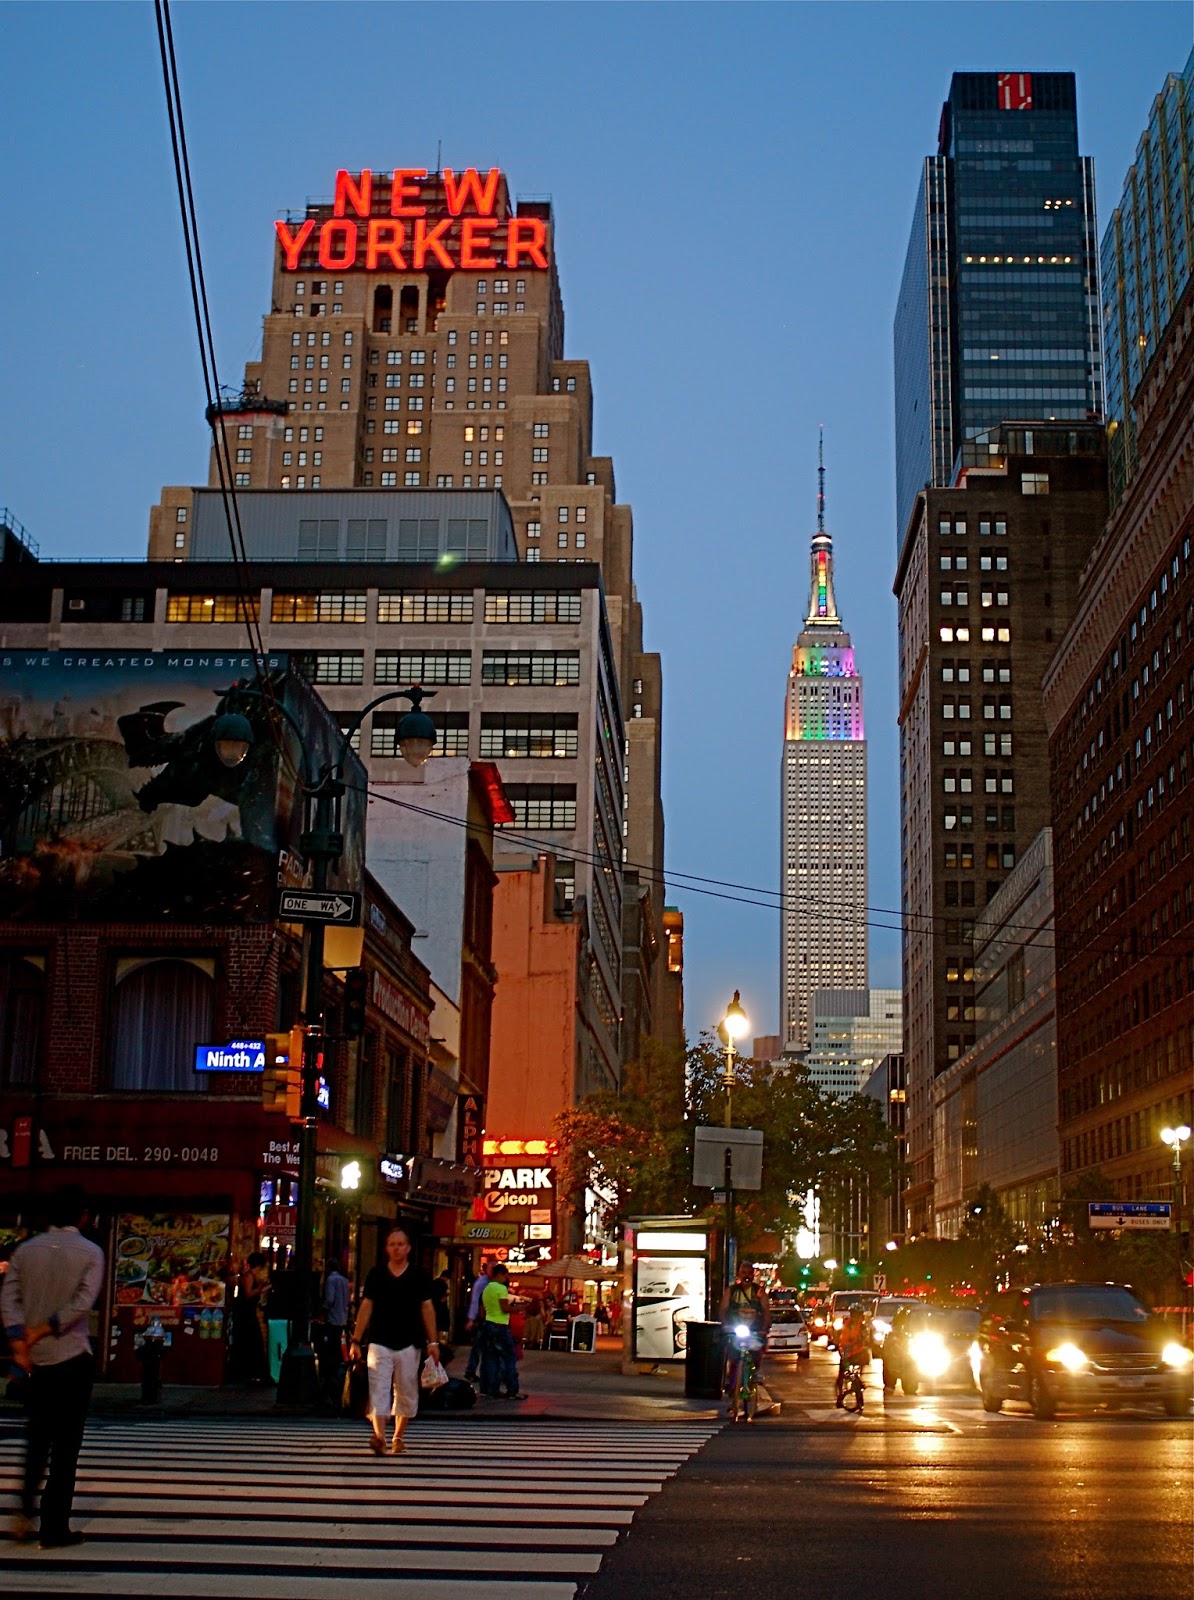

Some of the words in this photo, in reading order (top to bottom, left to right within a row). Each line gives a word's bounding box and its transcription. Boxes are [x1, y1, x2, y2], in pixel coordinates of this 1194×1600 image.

[333, 168, 501, 217] NEW
[274, 219, 549, 270] YORKER
[25, 657, 51, 666] WE
[63, 657, 155, 667] CREATED
[167, 657, 280, 668] MONSTERS
[286, 897, 308, 910] ONE
[320, 899, 343, 913] WAY
[206, 1050, 250, 1068] Ninth
[462, 1096, 478, 1166] ALPHA
[63, 1145, 100, 1161] FREE
[106, 1146, 138, 1161] DEL.
[144, 1147, 219, 1162] 290-0048
[269, 1141, 291, 1152] Best
[263, 1152, 281, 1164] The
[484, 1168, 552, 1188] PARK
[504, 1192, 538, 1205] icon
[468, 1228, 514, 1239] SUBWAY
